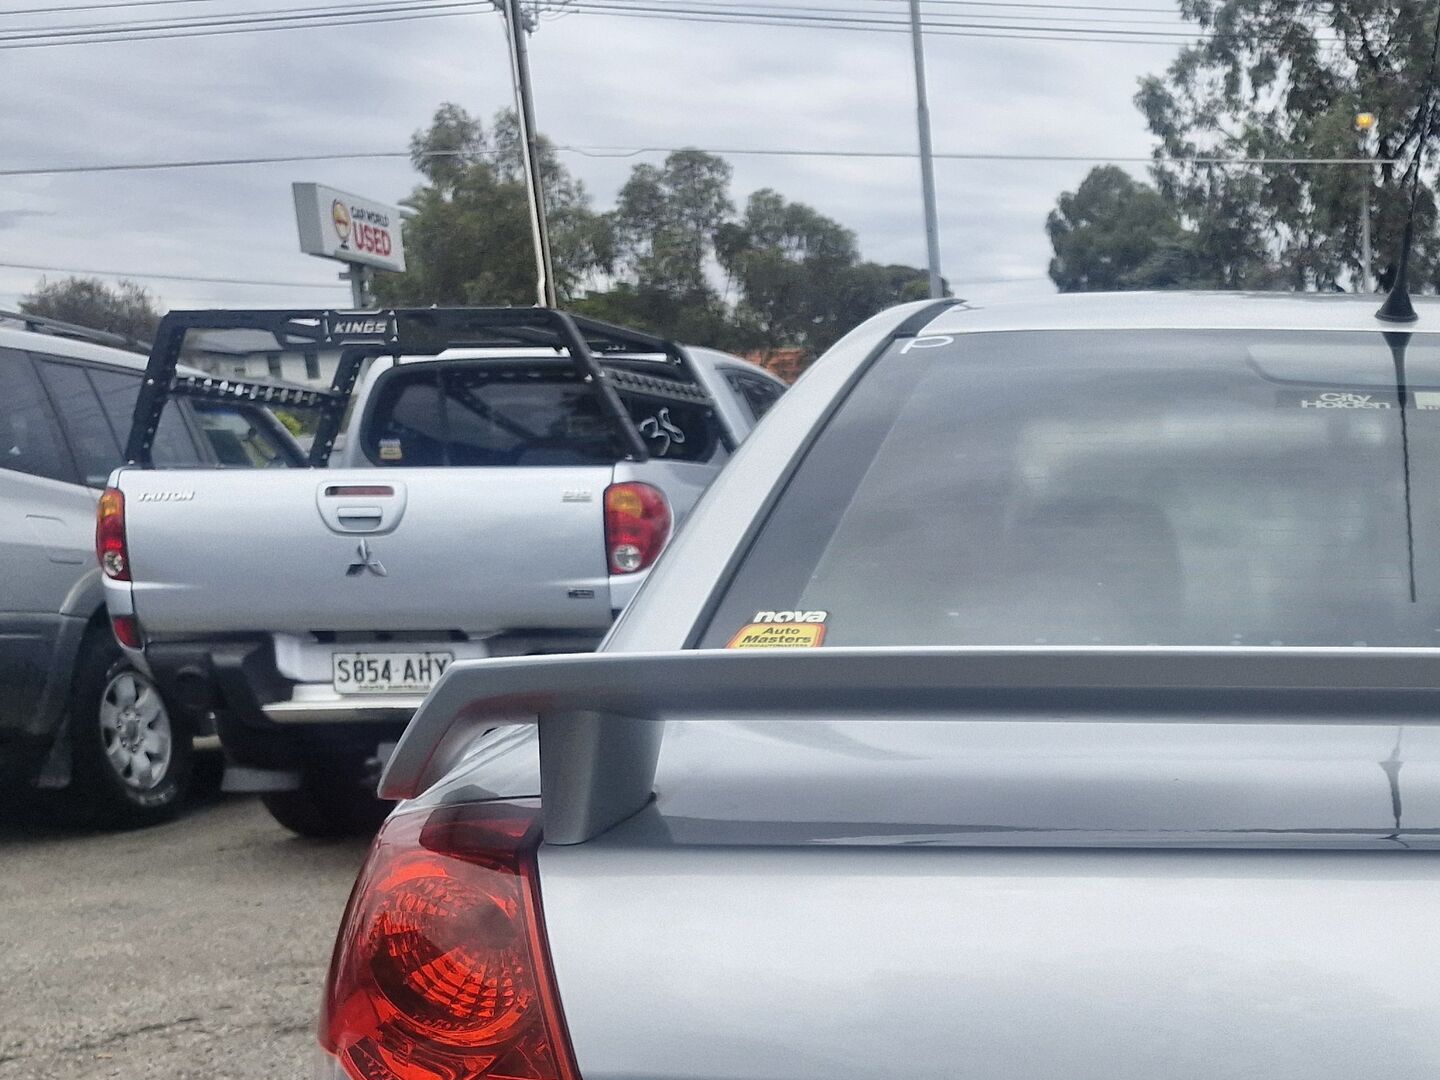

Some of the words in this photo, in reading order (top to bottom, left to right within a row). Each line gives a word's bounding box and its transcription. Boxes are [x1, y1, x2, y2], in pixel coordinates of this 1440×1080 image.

[352, 220, 392, 256] USED
[333, 320, 388, 334] KINGS
[1320, 392, 1372, 403] City
[1301, 400, 1391, 409] Holden
[752, 610, 828, 624] nova
[761, 627, 801, 635] Auto
[741, 635, 812, 644] Masters
